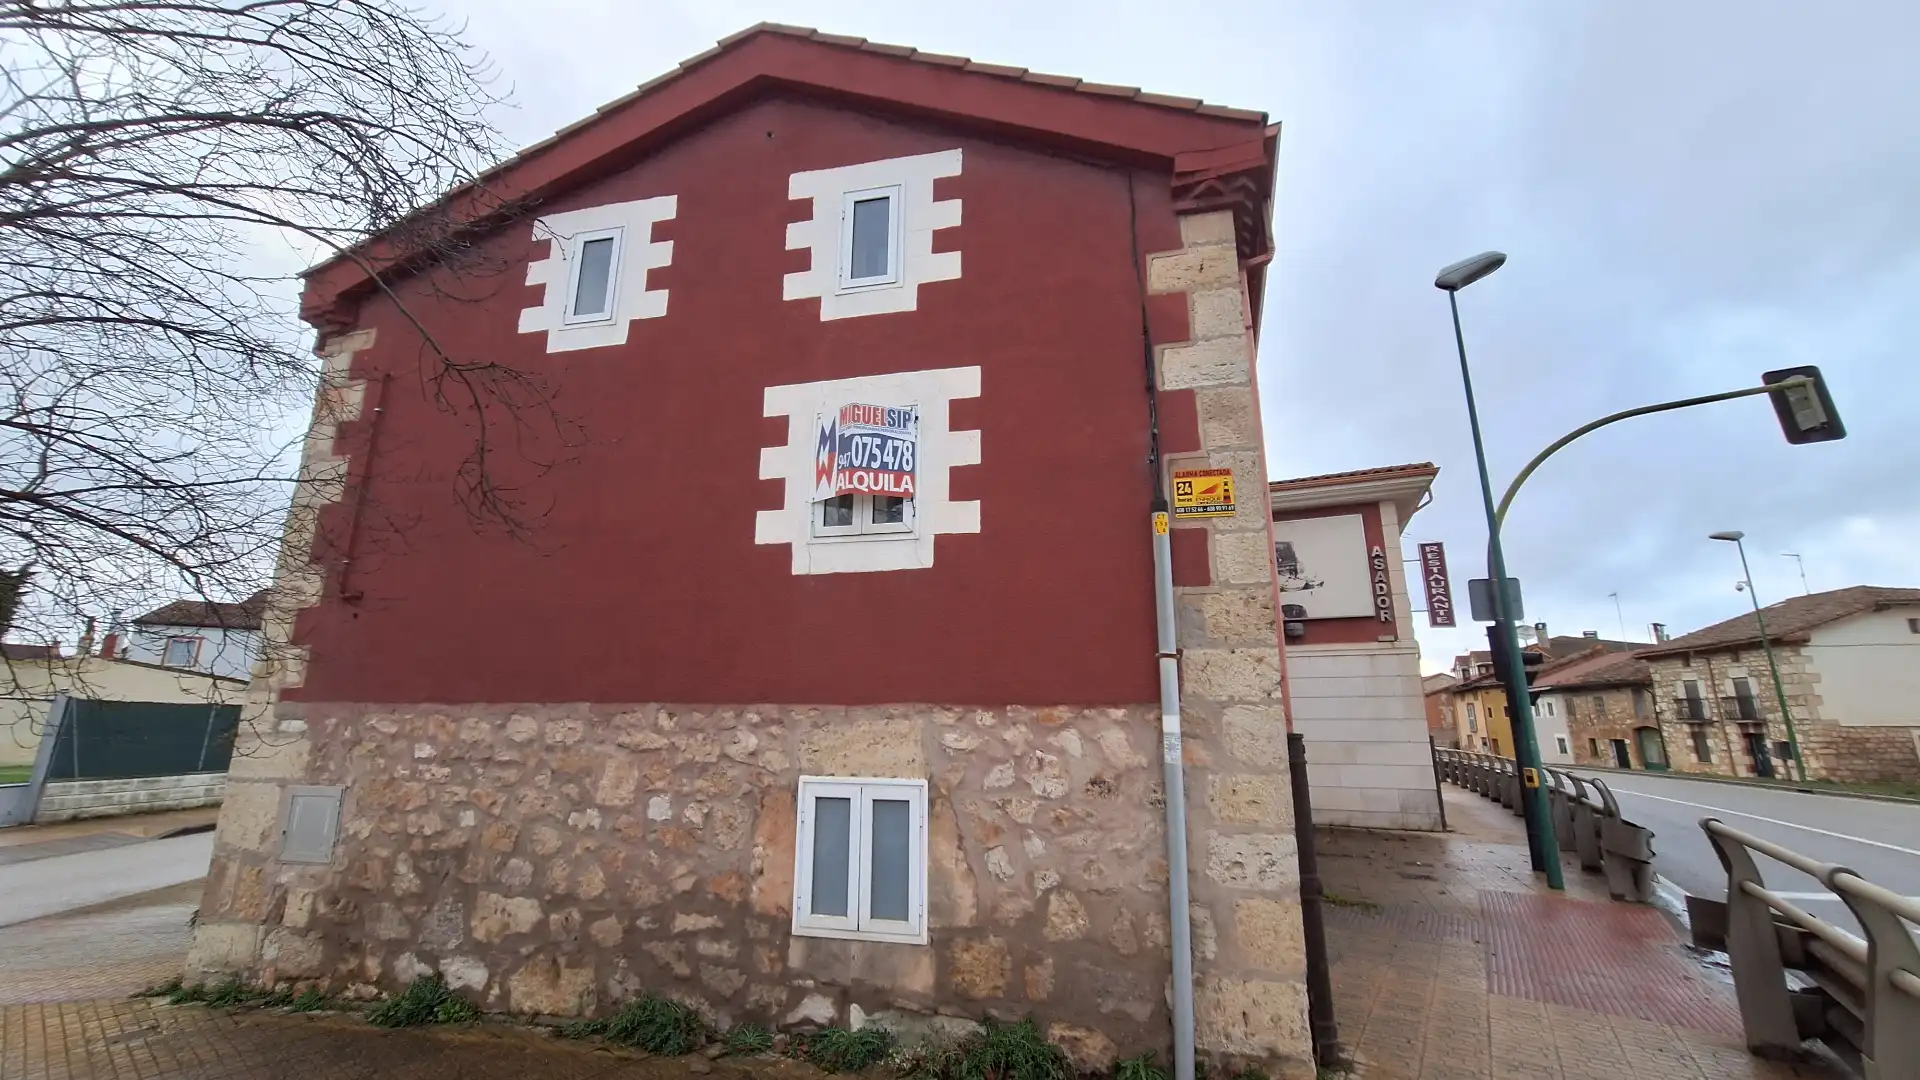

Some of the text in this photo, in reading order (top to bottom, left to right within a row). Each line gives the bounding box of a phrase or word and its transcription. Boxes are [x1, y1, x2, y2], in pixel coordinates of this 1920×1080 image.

[838, 452, 851, 469] 947
[836, 471, 914, 493] ALQUILA
[1177, 482, 1192, 494] 24
[1371, 545, 1392, 622] ASADOR
[1425, 546, 1449, 624] RESTAURANTE
